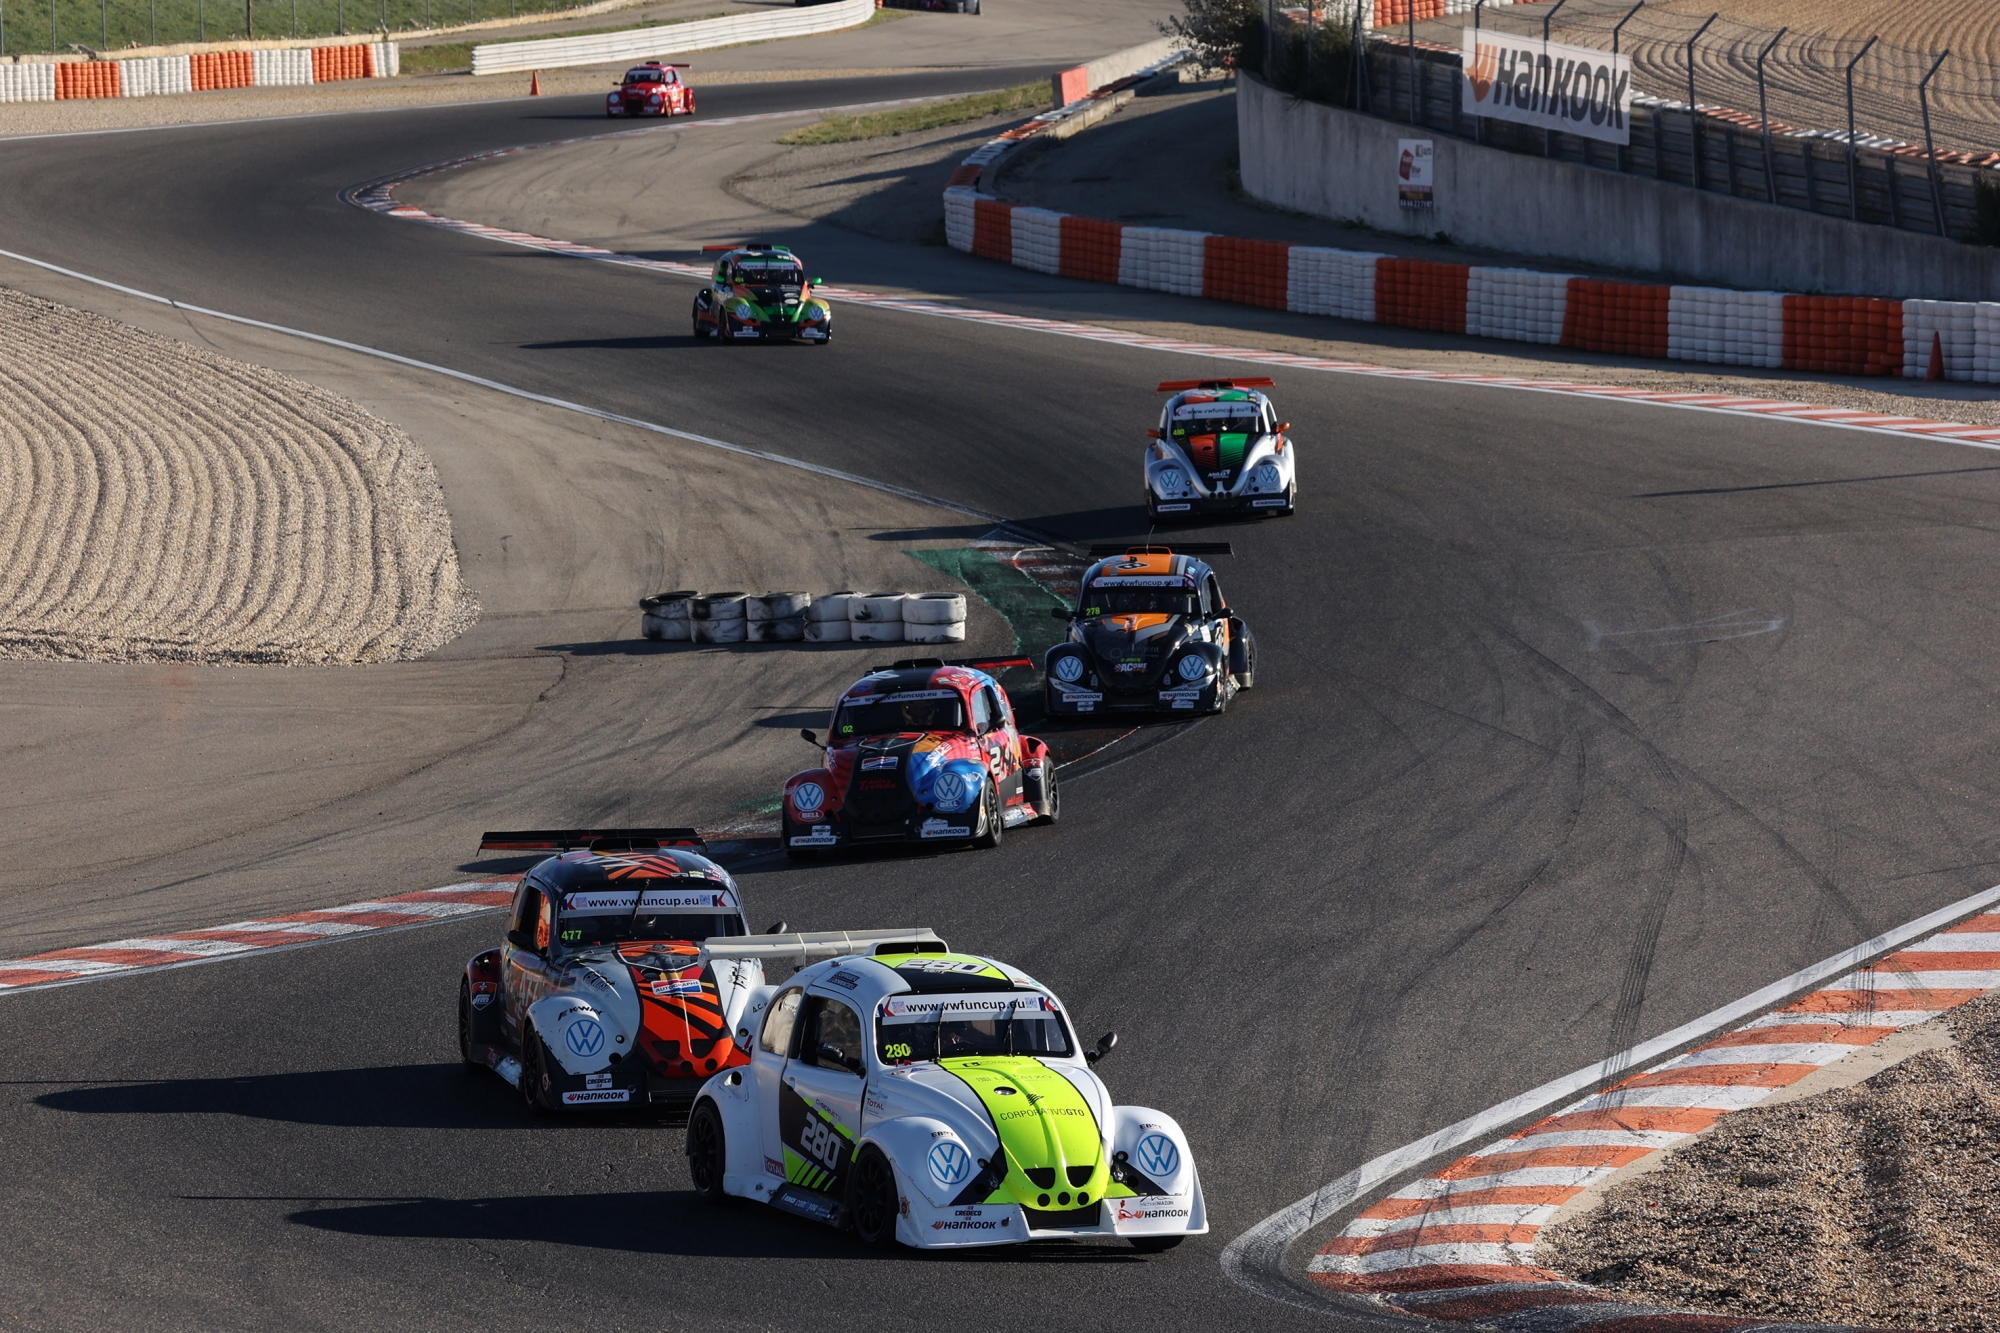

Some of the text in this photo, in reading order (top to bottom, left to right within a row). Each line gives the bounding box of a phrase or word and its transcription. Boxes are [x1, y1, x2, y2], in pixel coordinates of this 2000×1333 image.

[1086, 607, 1100, 616] 278
[842, 725, 853, 733] 02
[940, 800, 958, 808] BELL
[802, 811, 820, 819] BELL
[561, 930, 582, 941] 477
[896, 958, 989, 974] 280
[885, 1043, 911, 1059] 280
[866, 1098, 884, 1111] TOTAL
[800, 1111, 841, 1171] 280
